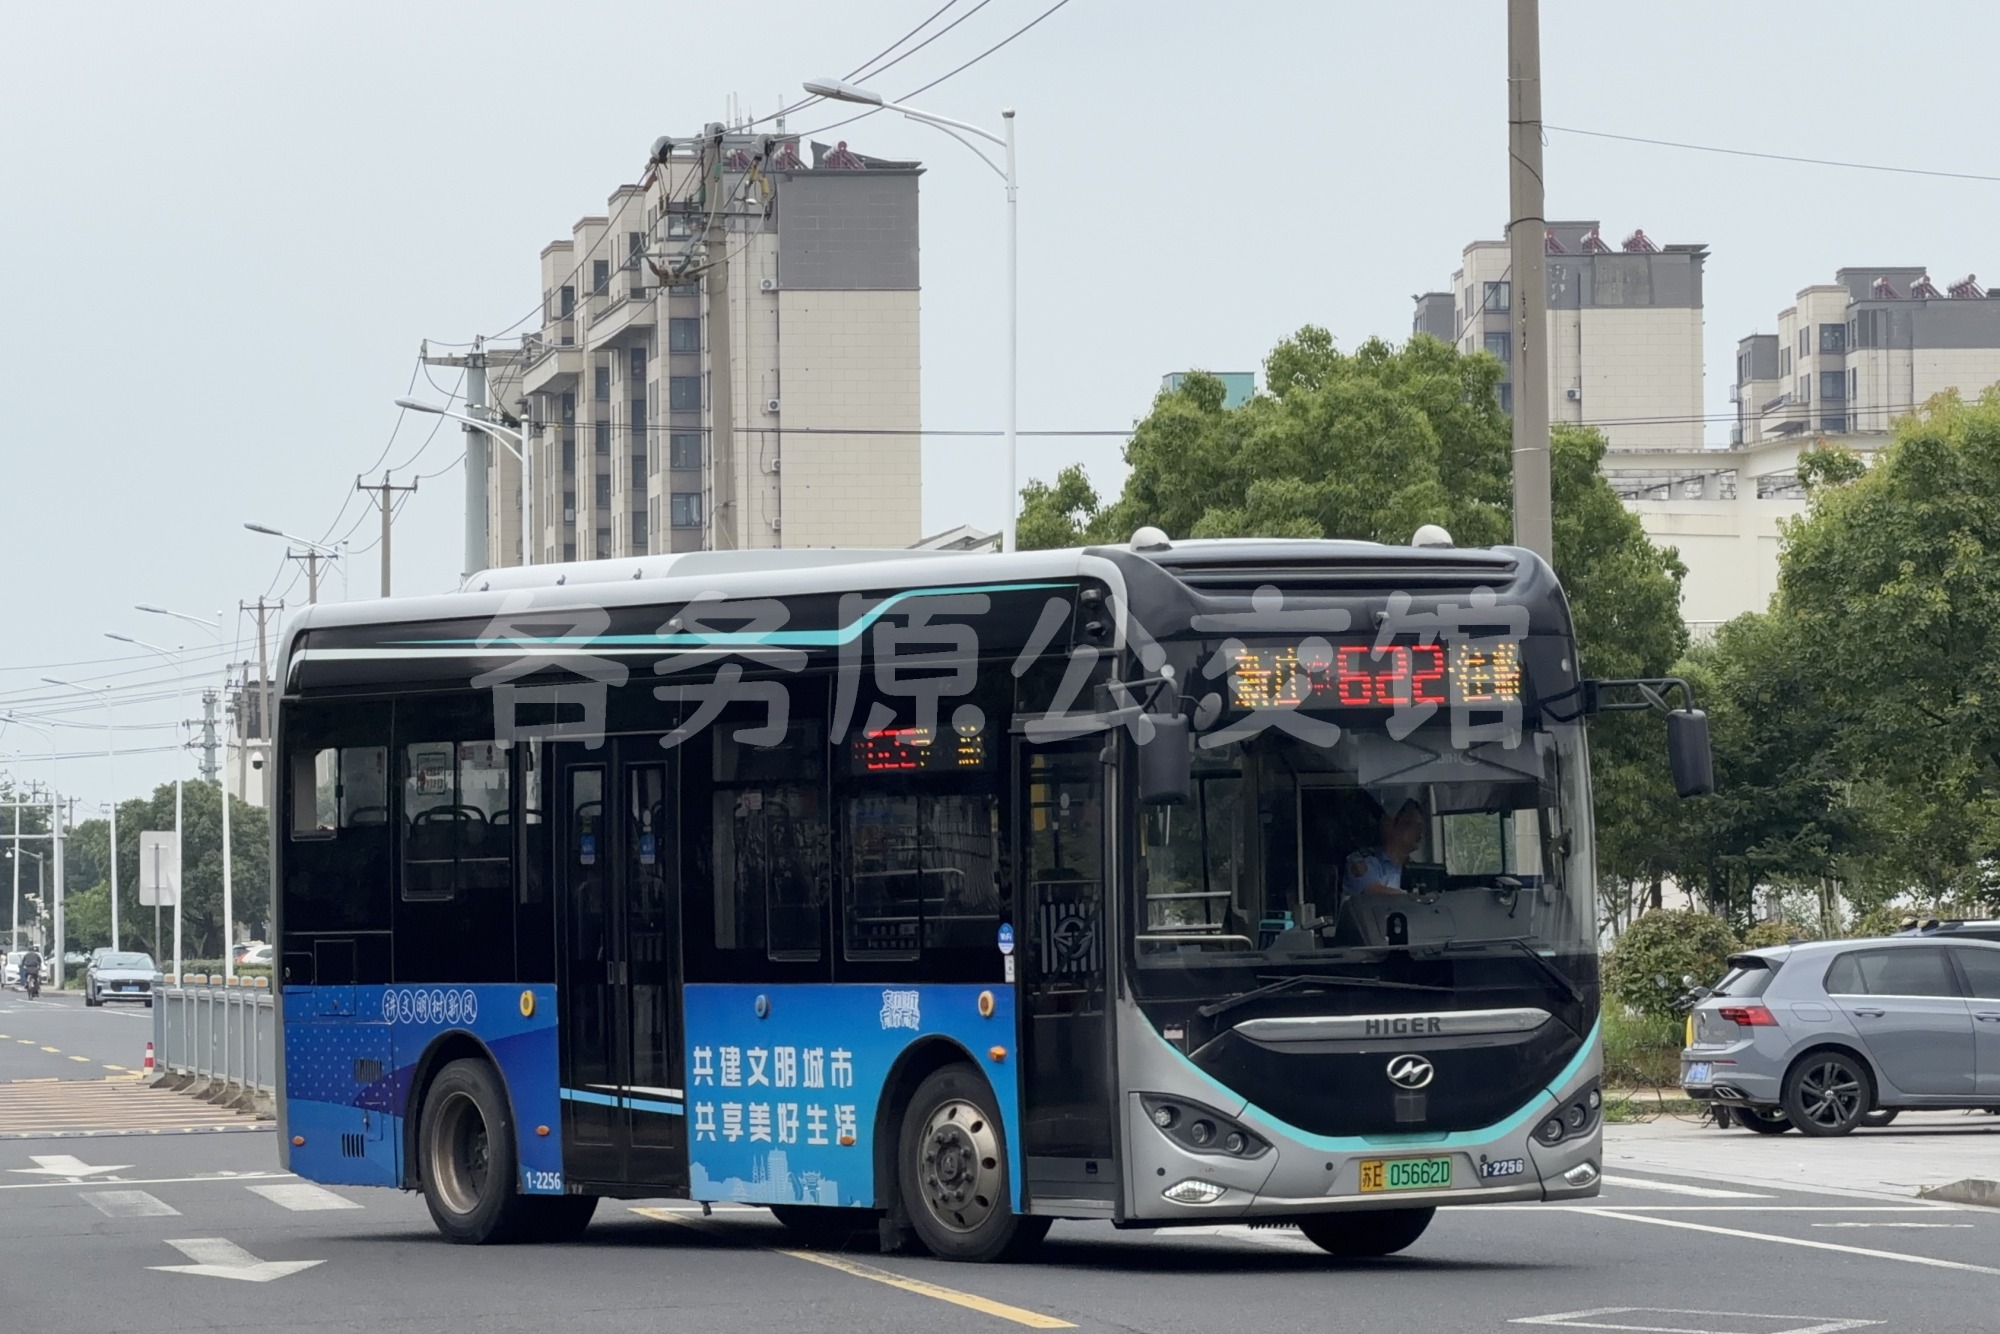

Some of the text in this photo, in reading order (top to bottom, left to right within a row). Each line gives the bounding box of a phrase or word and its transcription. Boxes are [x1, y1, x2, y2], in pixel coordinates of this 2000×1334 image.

[383, 990, 477, 1022] 讲文明树新风
[1365, 1017, 1441, 1035] HIGER
[693, 1046, 853, 1088] 共建文明城市
[695, 1102, 857, 1146] 共享美好生活
[526, 1171, 561, 1190] 1-2256
